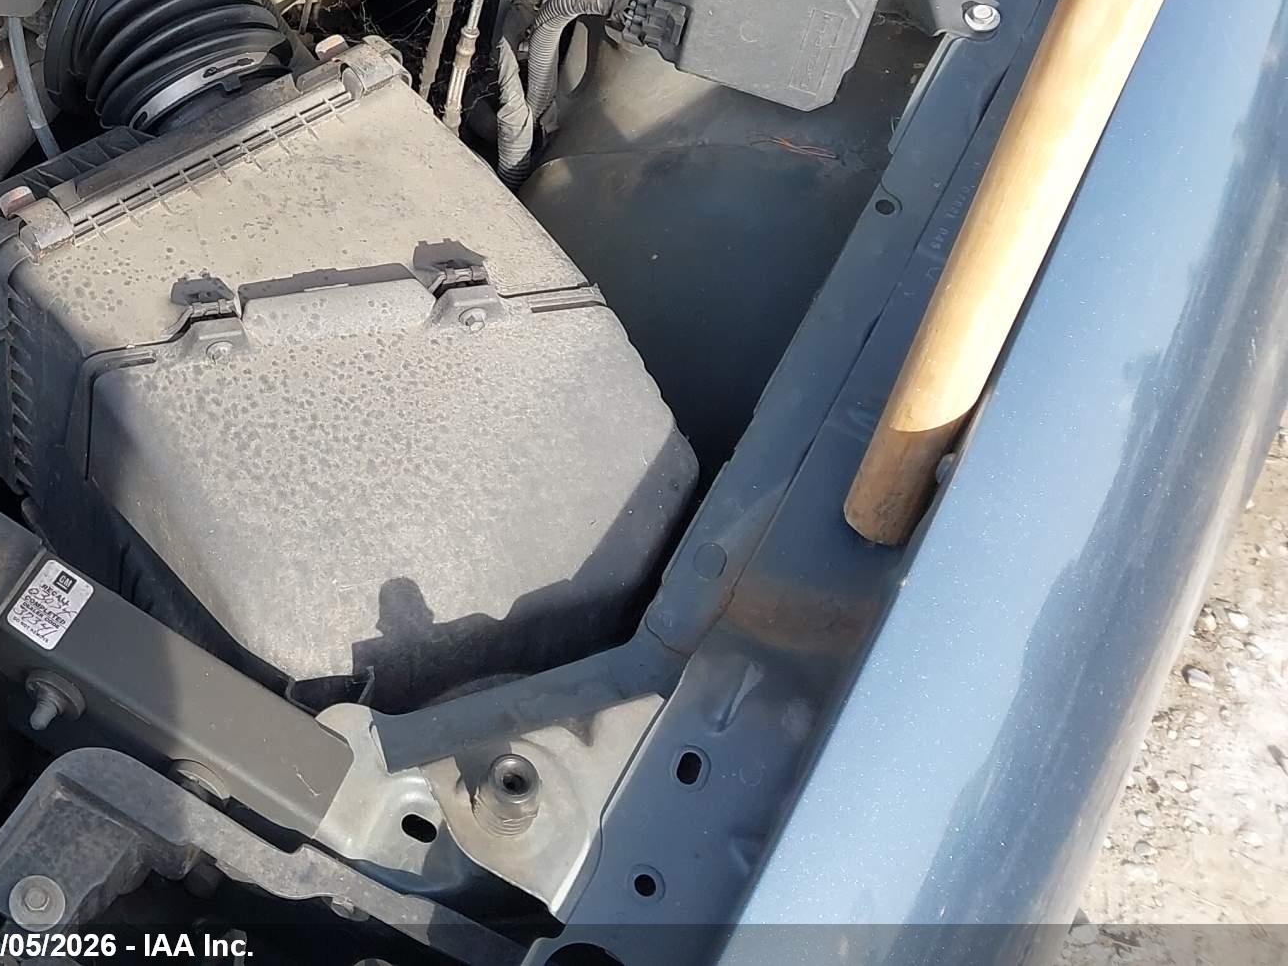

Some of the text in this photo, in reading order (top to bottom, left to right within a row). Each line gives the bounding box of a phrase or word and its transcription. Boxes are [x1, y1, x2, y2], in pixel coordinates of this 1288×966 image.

[41, 583, 71, 606] RECALL
[22, 601, 61, 629] DEALER CODE
[24, 595, 67, 625] COMPLETED
